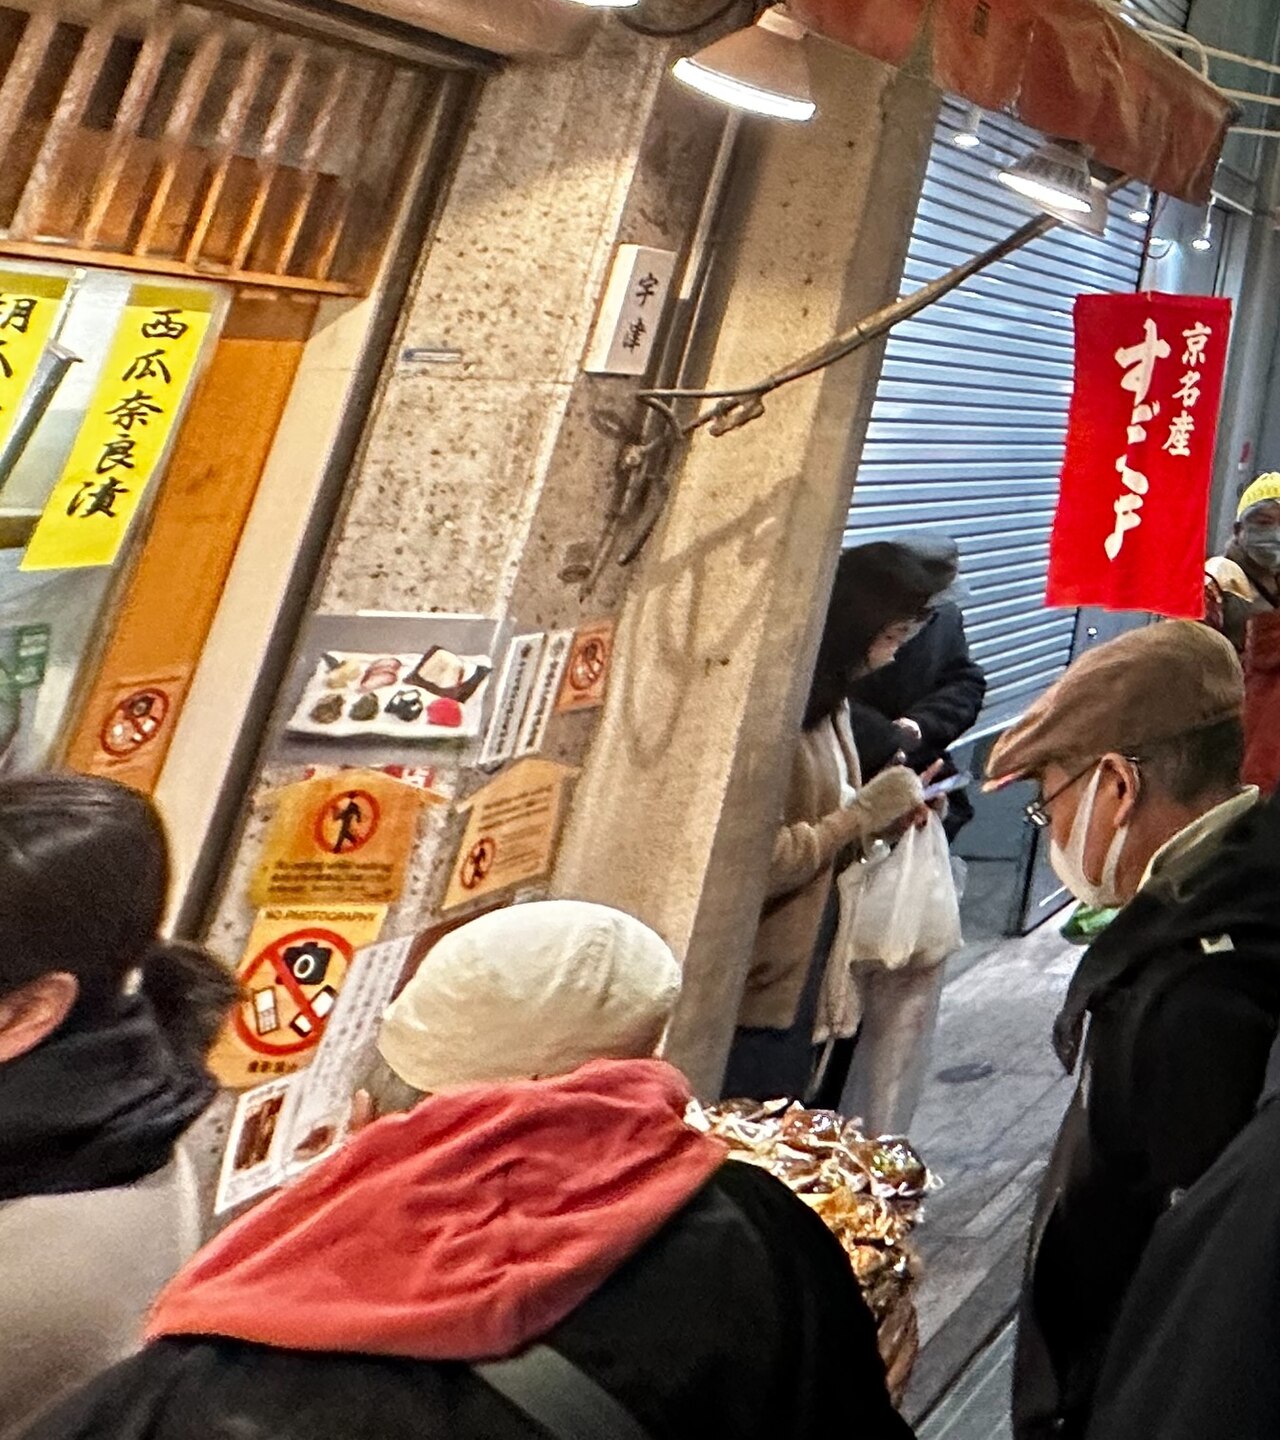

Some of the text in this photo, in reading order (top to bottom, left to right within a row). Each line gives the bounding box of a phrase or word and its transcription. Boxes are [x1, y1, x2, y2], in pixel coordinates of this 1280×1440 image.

[66, 308, 188, 519] 西瓜奈良漬
[1161, 320, 1212, 457] 京名産
